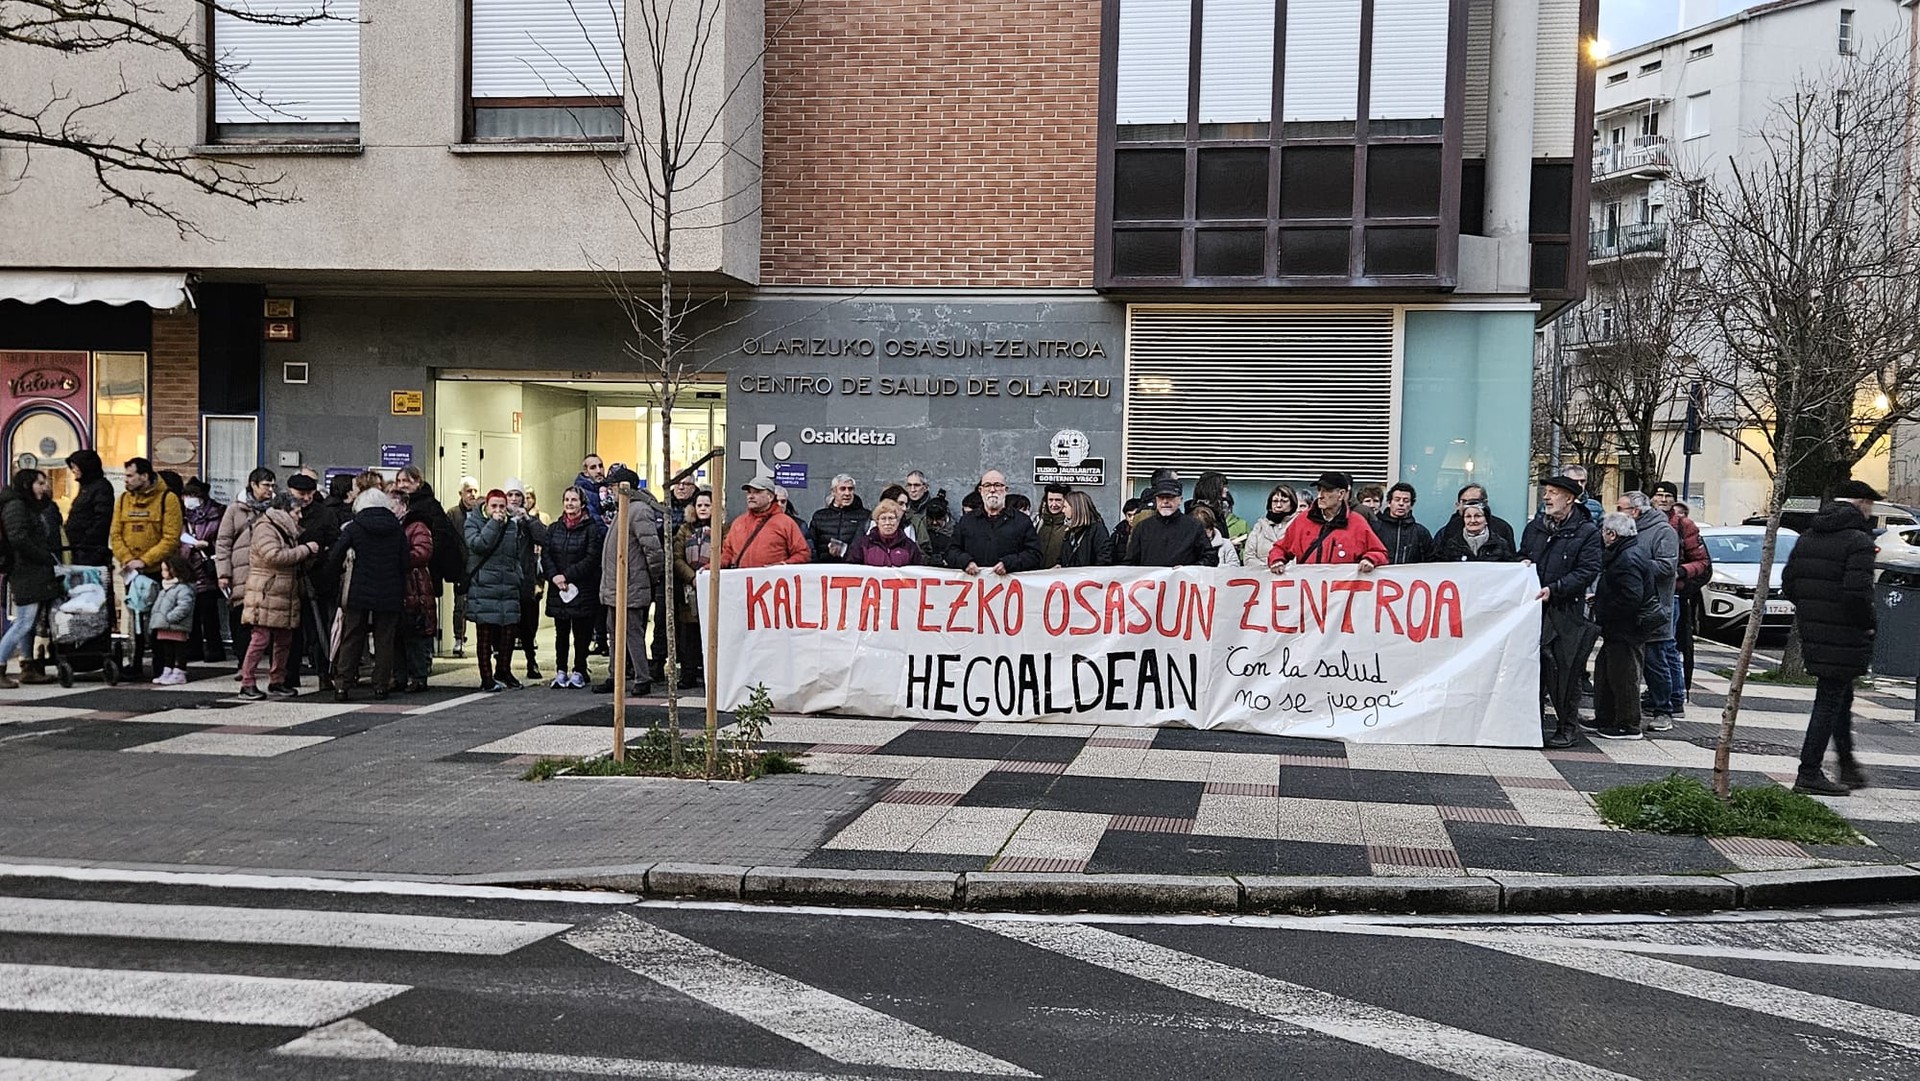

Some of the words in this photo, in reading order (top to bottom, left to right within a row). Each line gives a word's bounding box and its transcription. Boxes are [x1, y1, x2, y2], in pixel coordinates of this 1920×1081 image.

[741, 337, 876, 358] OLARIZUKO
[884, 338, 1107, 359] OSASUN-ZENTROA
[739, 375, 833, 395] CENTRO
[841, 376, 872, 396] DE
[880, 376, 960, 396] SALUD
[967, 377, 1000, 397] DE
[1006, 378, 1111, 398] OLARIZU
[799, 426, 897, 446] Osakidetza
[746, 574, 1024, 636] KALITATEZKO
[1043, 579, 1217, 642] OSASUN
[1226, 578, 1464, 643] ZENTROA
[1279, 646, 1308, 679] la
[1313, 652, 1388, 684] salud
[906, 648, 1198, 717] HEGOALDEAN
[1234, 688, 1272, 712] no
[1278, 690, 1314, 713] se
